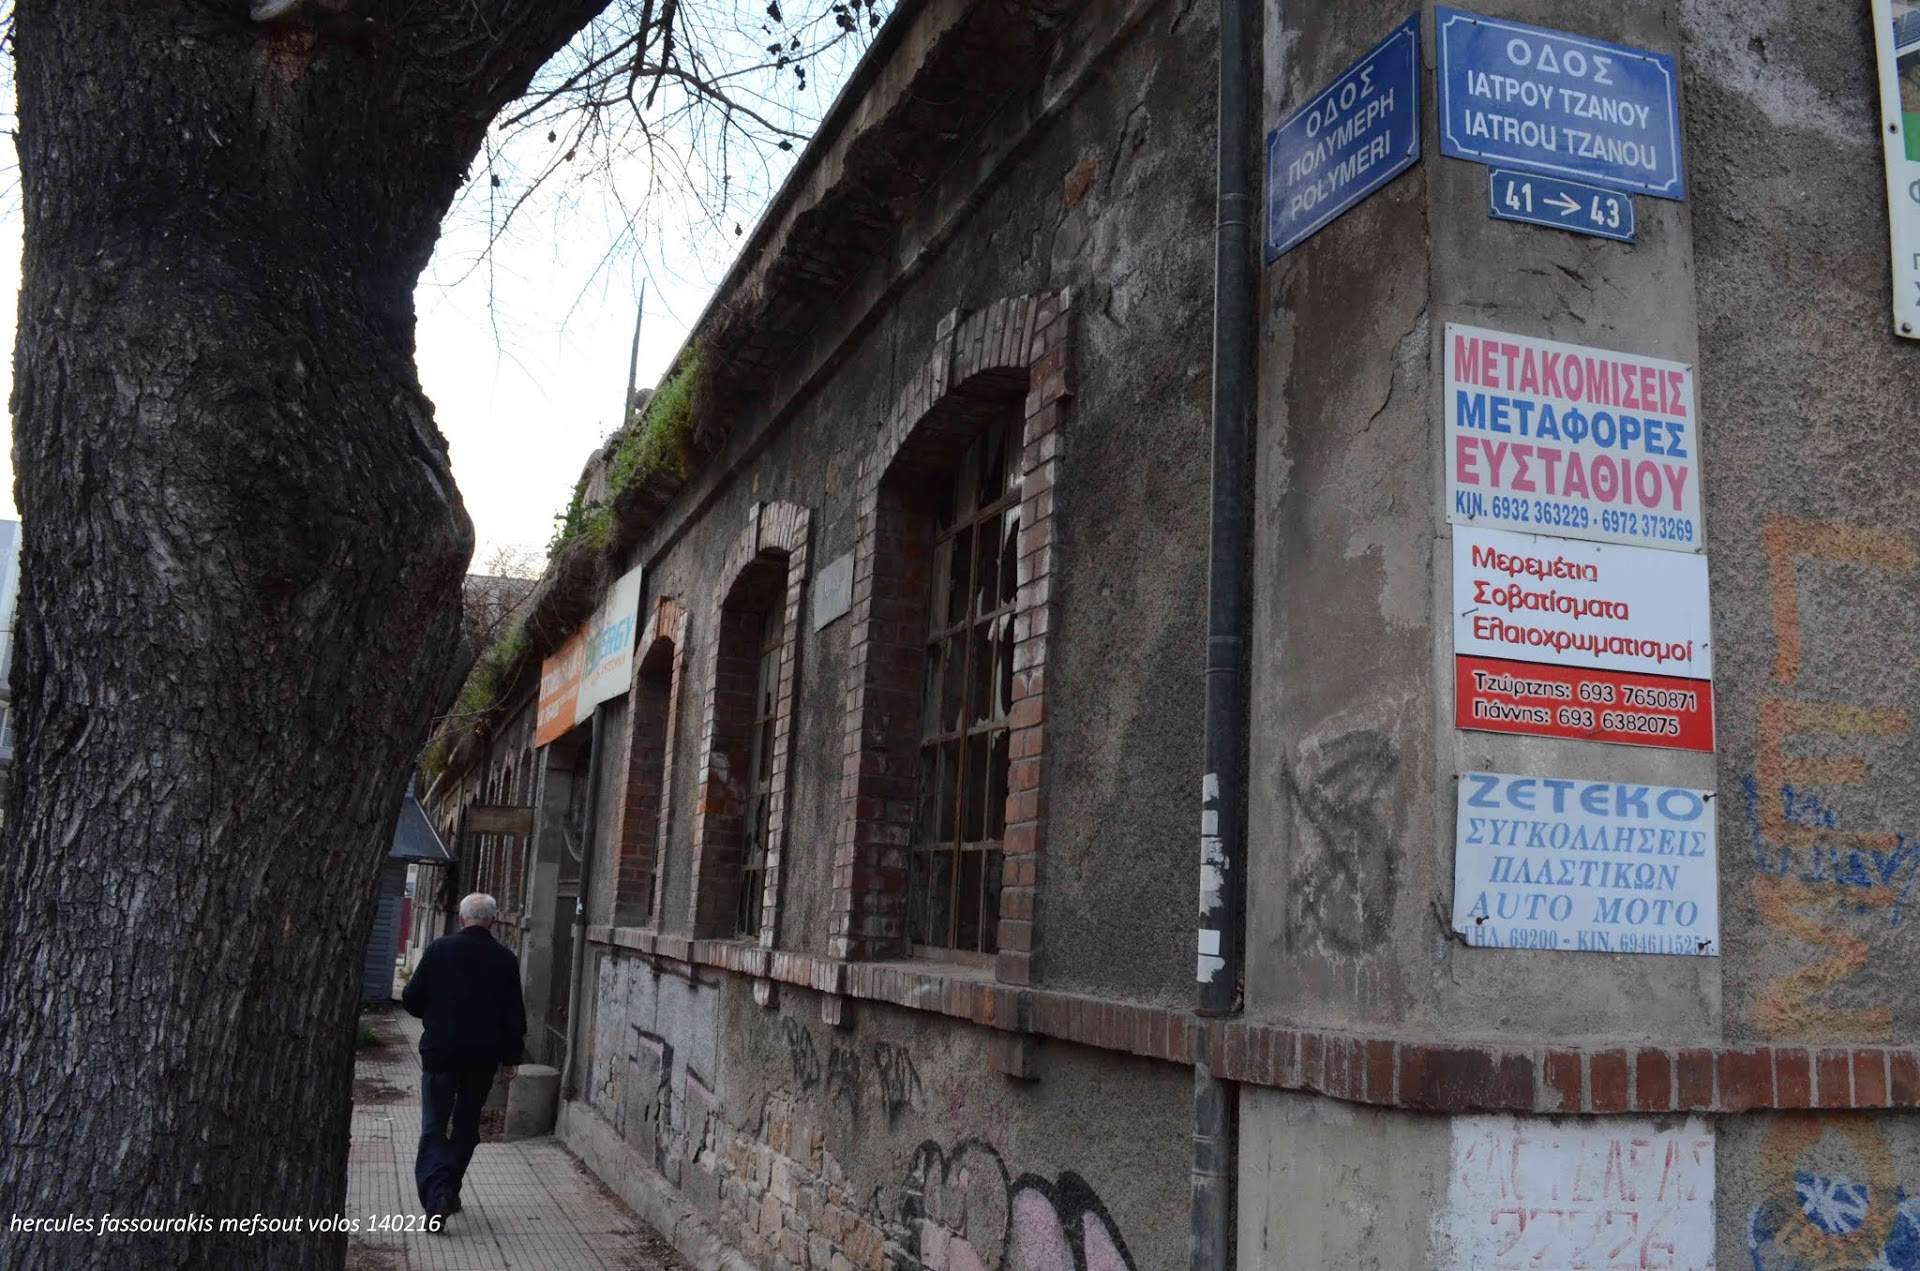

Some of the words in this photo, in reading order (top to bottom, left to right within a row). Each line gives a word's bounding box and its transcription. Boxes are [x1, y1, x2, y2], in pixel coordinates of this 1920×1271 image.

[1507, 39, 1613, 86] ΟΔΟΣ
[1306, 64, 1374, 138] ΟΔΟΣ
[1467, 69, 1554, 109] ΙΑΤΡΟΥ
[1559, 88, 1650, 129] ΤΖΑΝΟΥ
[1288, 87, 1395, 187] ΠΟΛΥΜΕΡΗ
[1465, 109, 1556, 151] IATROU
[1562, 128, 1656, 171] TZANOU
[1290, 130, 1390, 221] POLYMERI
[1505, 180, 1532, 212] 41
[1590, 195, 1620, 228] 43
[1454, 335, 1687, 417] ΜΕΤΑΚΟΜΙΣΕΙΣ
[1456, 390, 1688, 458] ΜΕΤΑΦΟΡΕΣ
[1456, 435, 1689, 512] ΕΥΣΤΑΘΙΟΥ
[1455, 490, 1488, 517] ΚΙΝ.
[1492, 495, 1530, 522] 6932
[1534, 501, 1588, 529] 363229
[1602, 509, 1637, 535] 6972
[1642, 518, 1693, 543] 373269
[1471, 545, 1598, 582] Μερεμέτια
[1473, 580, 1629, 620] Σοβατίσματα
[1474, 615, 1693, 664] Ελαιοχρωματισμοί
[1473, 700, 1550, 724] Γιάννης:
[1558, 708, 1594, 728] 693
[1602, 711, 1679, 735] 6382075
[1579, 683, 1614, 703] 693
[1623, 687, 1697, 711] 7650871
[1465, 817, 1707, 857] ΣΥΓΚΟΛΛΗΣΕΙΣ
[1488, 855, 1680, 892] ΠΛΑΣΤΙΚΩΝ
[1467, 890, 1573, 922] AUTO
[1592, 897, 1699, 927] MOTO
[1509, 928, 1558, 950] 69200
